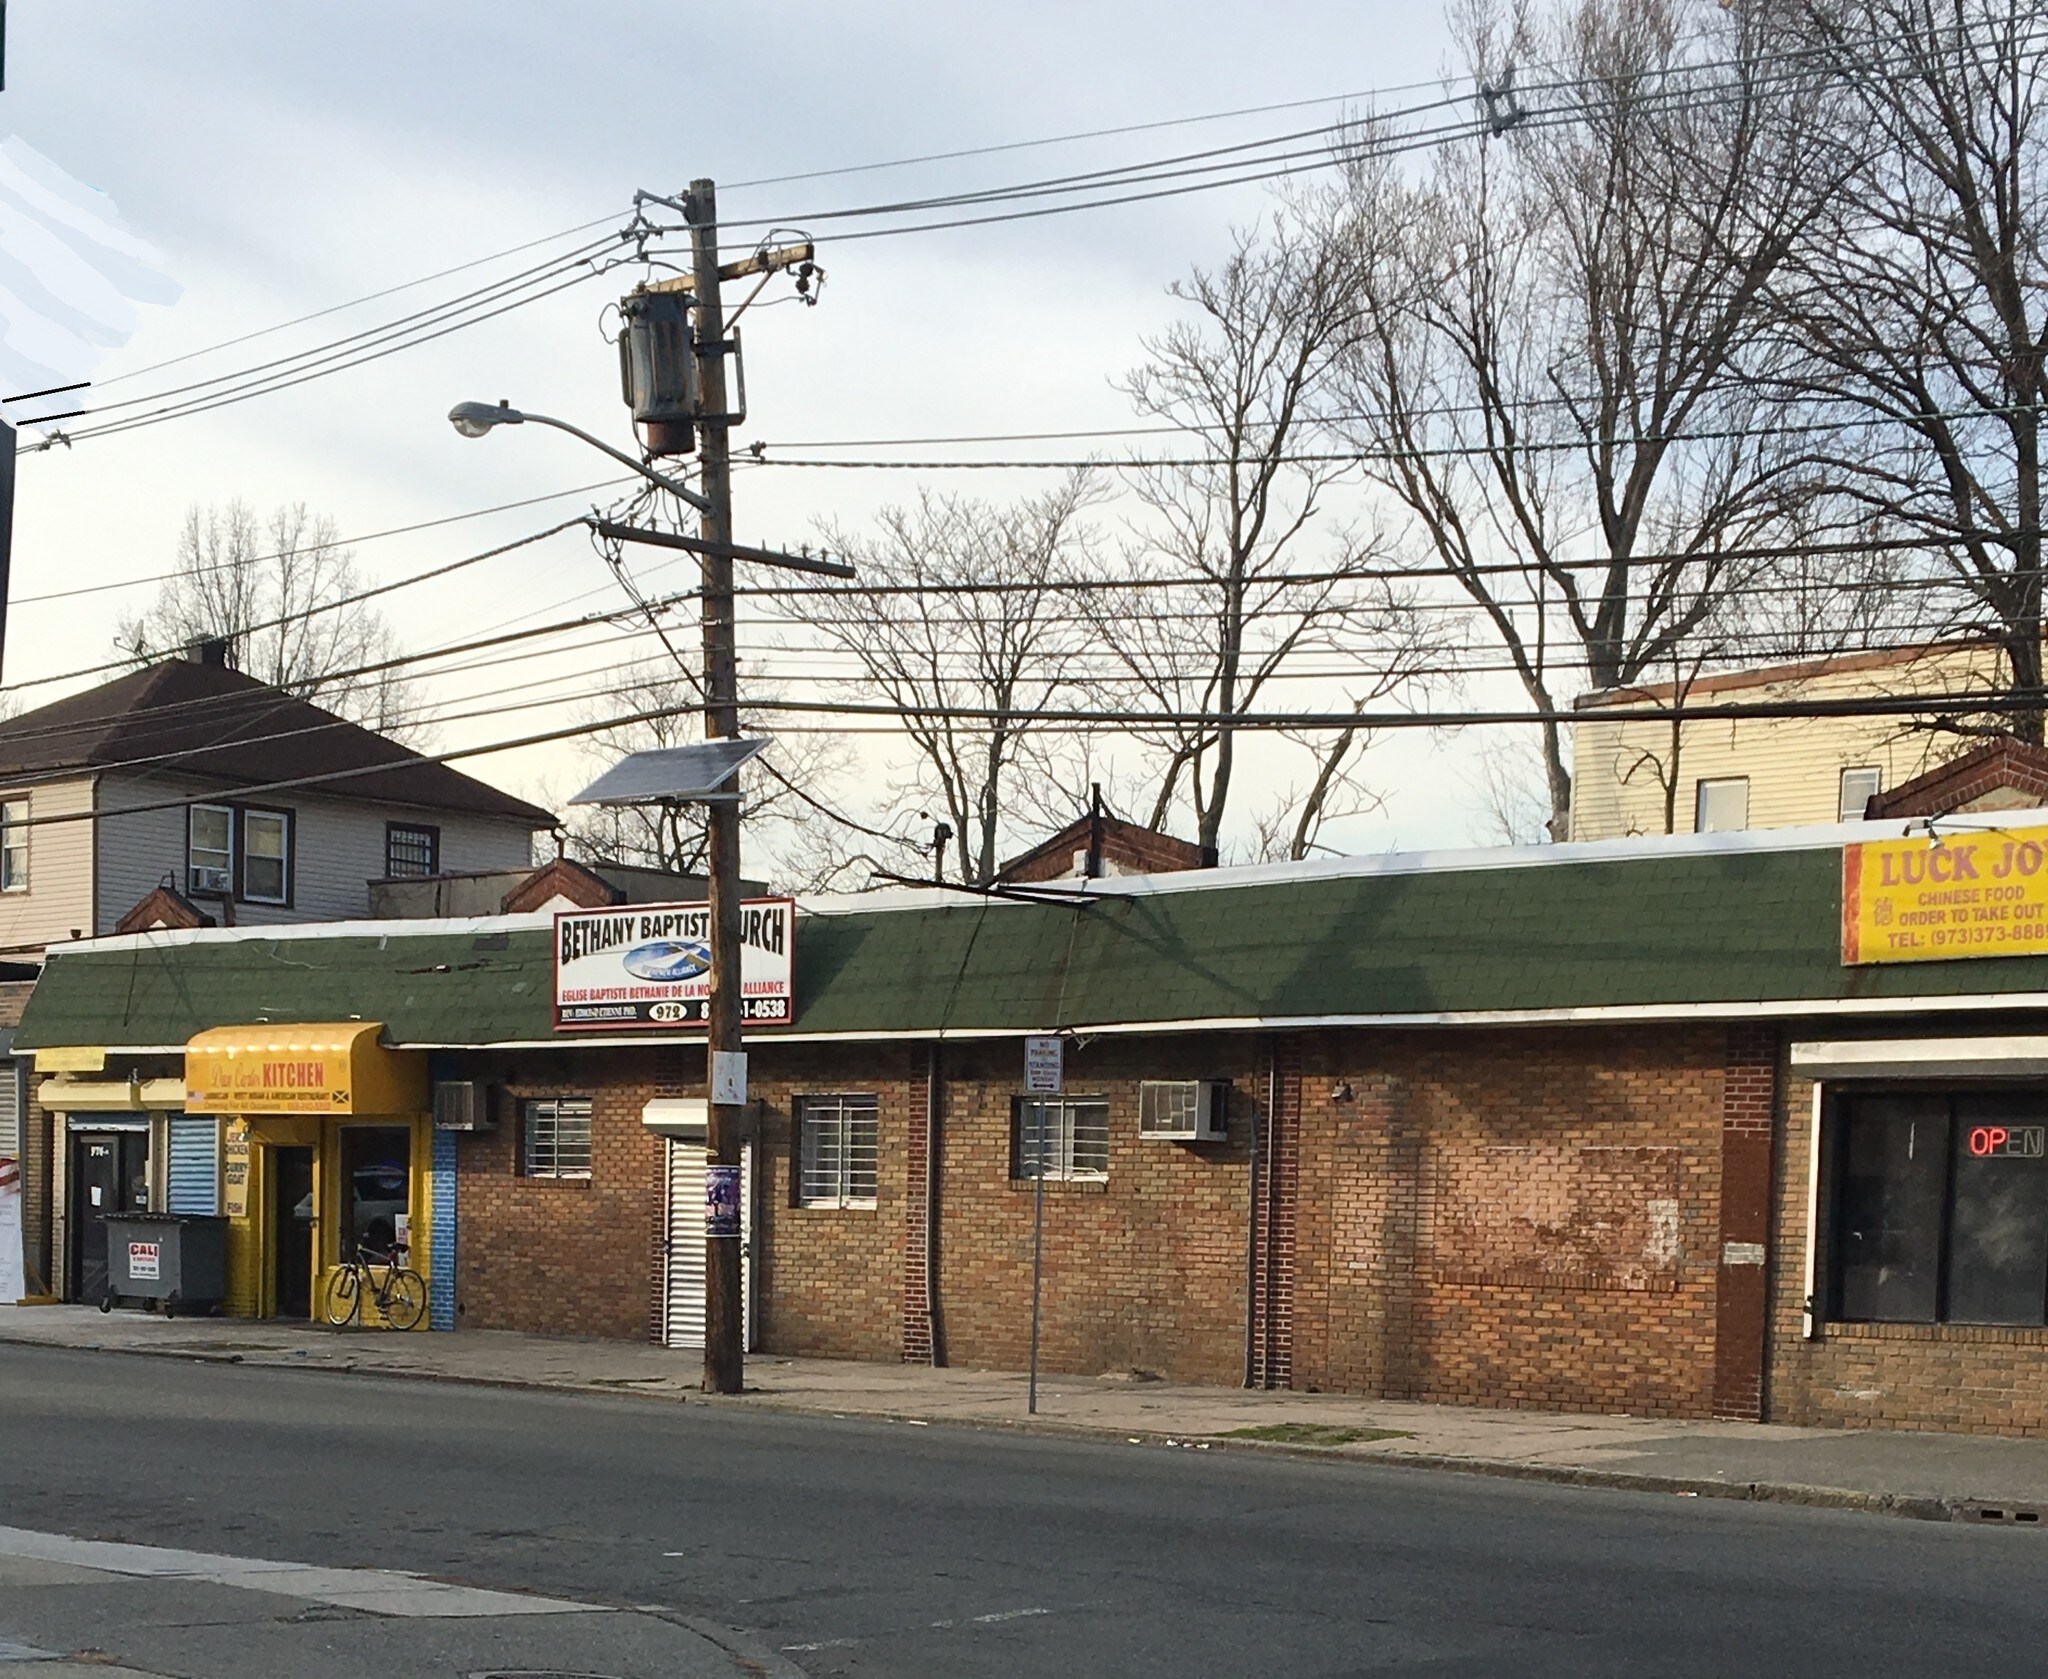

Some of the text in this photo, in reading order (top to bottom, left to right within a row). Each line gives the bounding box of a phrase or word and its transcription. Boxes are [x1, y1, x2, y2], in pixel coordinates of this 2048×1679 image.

[1880, 838, 2048, 887] LUCK JO
[1918, 885, 2025, 906] CHINESE FOOD
[1900, 903, 2045, 926] ORDER TO TAKE OUT
[561, 908, 784, 966] BETHANY BAPTIST URCH
[1888, 932, 1925, 948] TEL:
[562, 989, 587, 1002] EGLISE
[590, 987, 626, 1001] BAPTISTE
[629, 985, 669, 999] BETHANIE
[671, 984, 683, 998] DE
[684, 984, 695, 997] LA
[743, 981, 785, 994] ALLIANCE
[656, 1005, 680, 1019] 972
[263, 1062, 324, 1088] KITCHEN
[1970, 1127, 2042, 1155] OPEN
[130, 1244, 158, 1257] CALI
